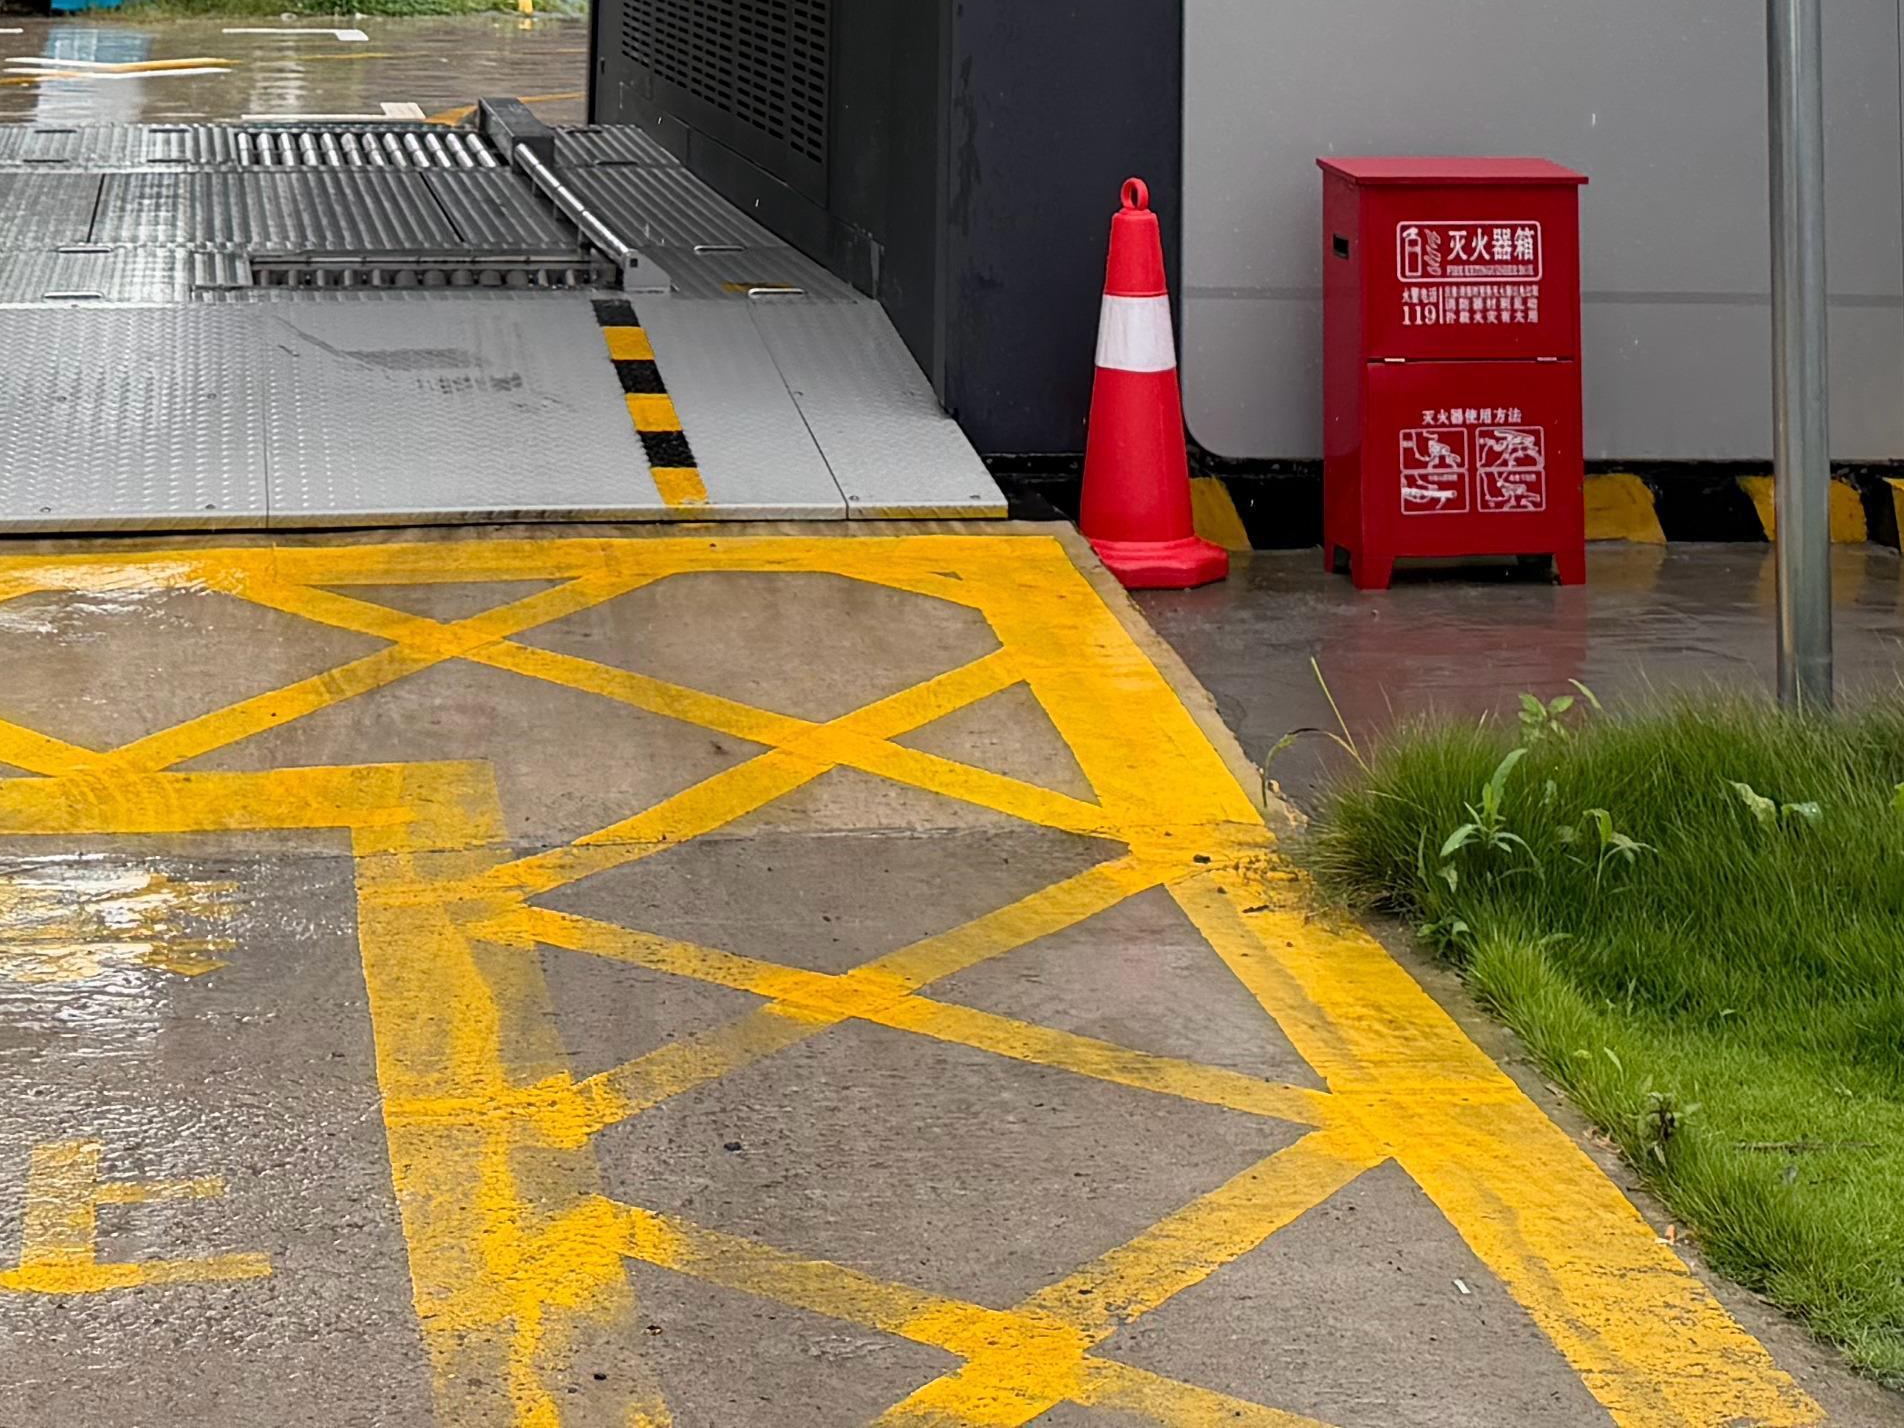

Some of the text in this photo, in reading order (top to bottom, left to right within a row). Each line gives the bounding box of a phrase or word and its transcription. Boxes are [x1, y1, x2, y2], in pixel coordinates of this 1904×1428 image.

[1446, 226, 1535, 262] 灭火器箱
[1402, 304, 1437, 326] 119
[1421, 407, 1523, 425] 灭火器使用方法
